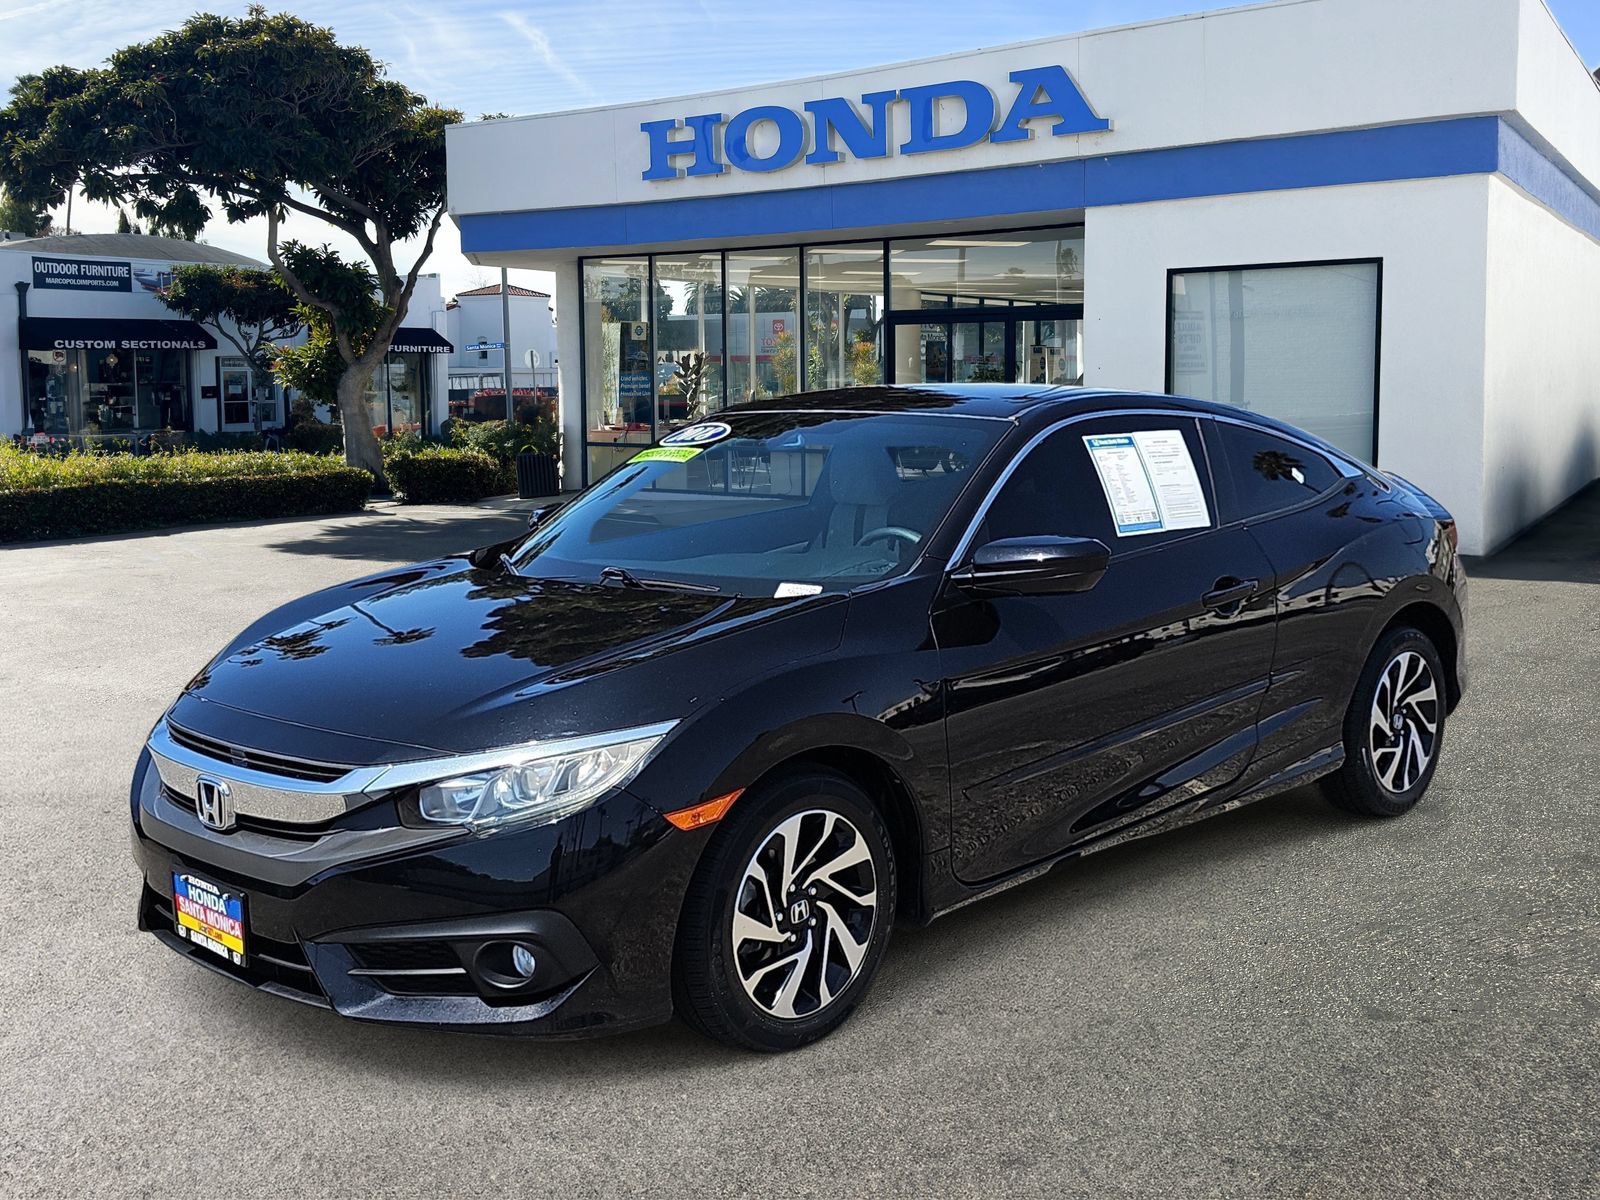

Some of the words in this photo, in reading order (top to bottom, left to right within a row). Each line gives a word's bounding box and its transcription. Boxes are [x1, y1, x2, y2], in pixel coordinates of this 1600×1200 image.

[640, 64, 1112, 182] HONDA
[34, 261, 79, 275] OUTDOOR
[80, 264, 130, 277] FURNITURE
[45, 277, 120, 287] MARCOPOLOIMPORTS.COM
[54, 339, 116, 349] CUSTOM
[121, 340, 206, 349] SECTIONALS
[388, 345, 450, 353] FURNITURE
[188, 885, 227, 915] HONDA
[179, 896, 206, 923] SANTA
[206, 909, 242, 939] MONICA
